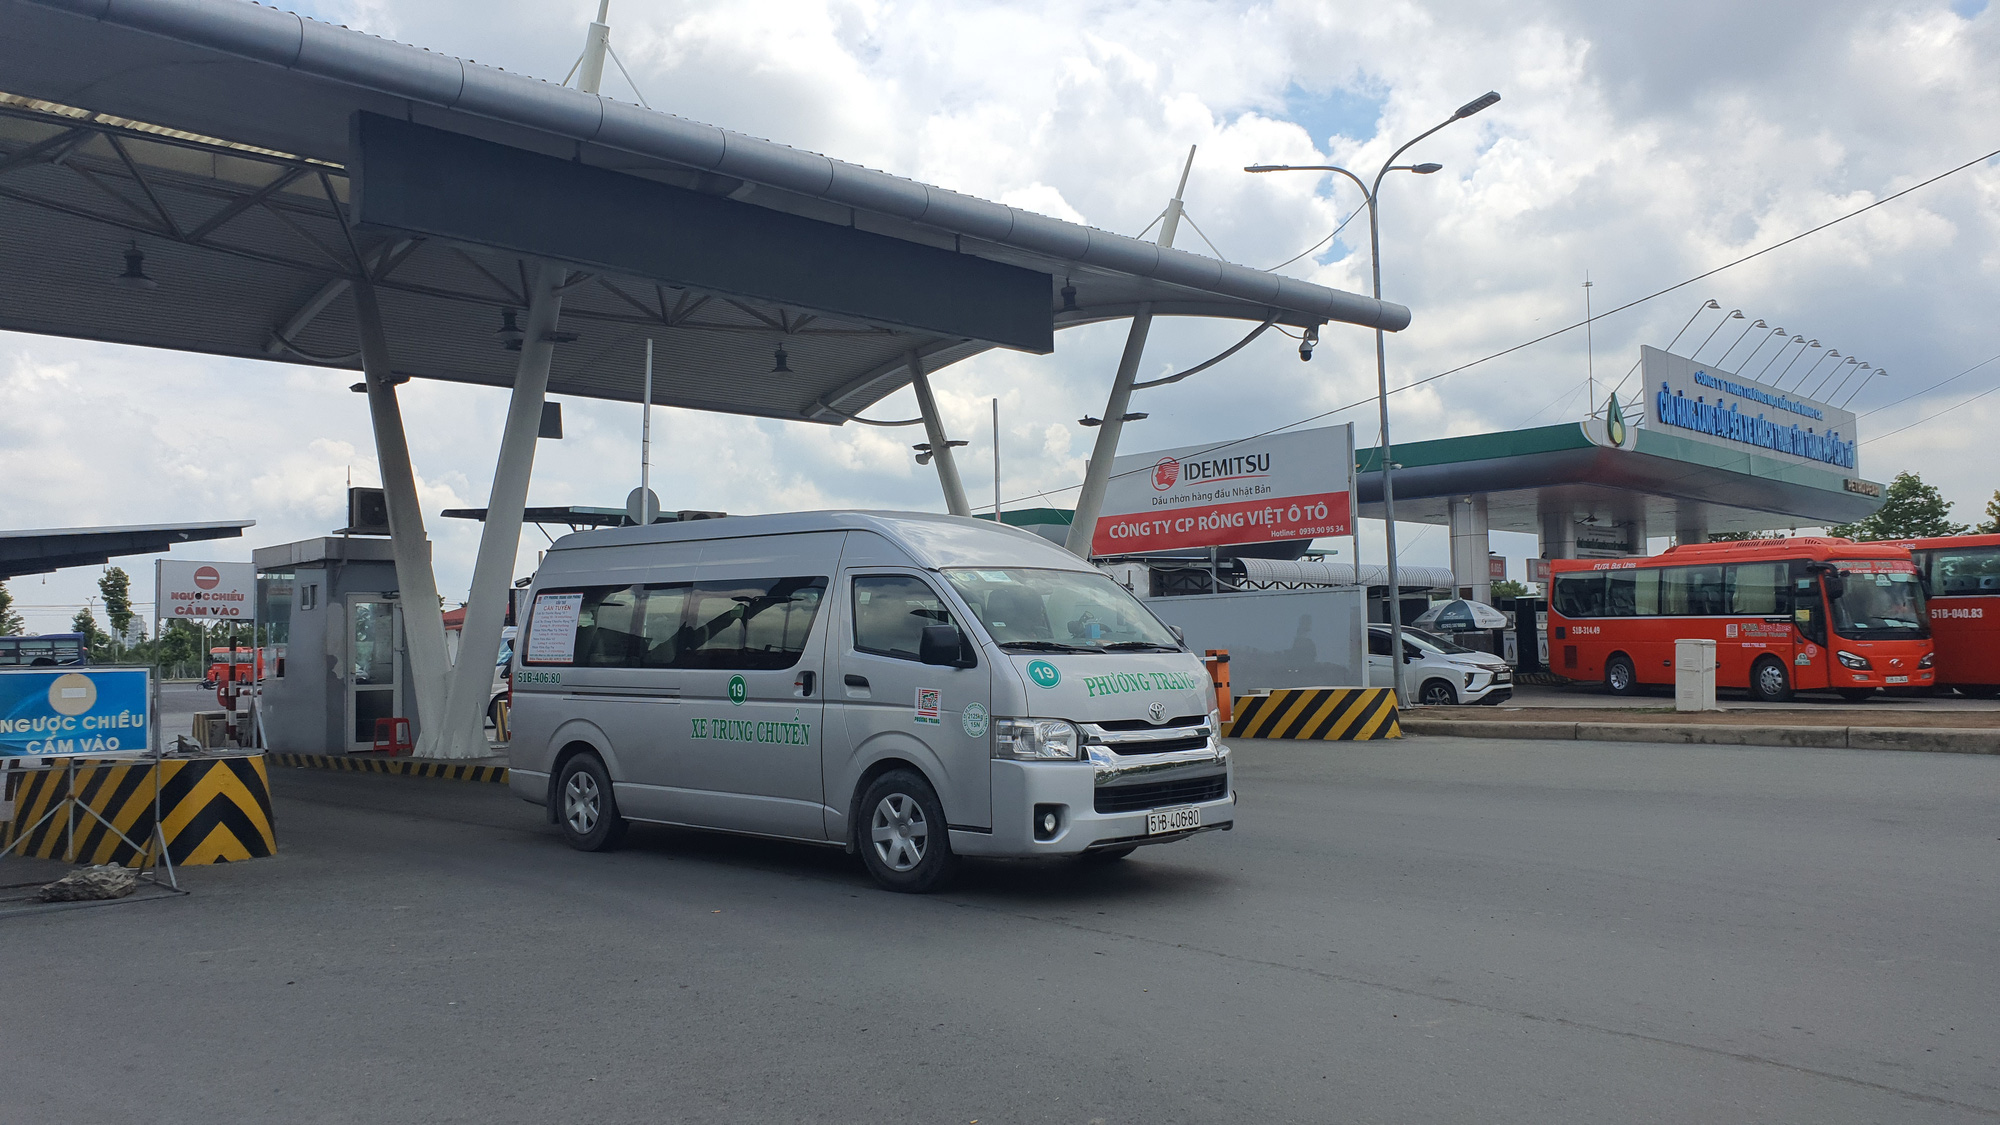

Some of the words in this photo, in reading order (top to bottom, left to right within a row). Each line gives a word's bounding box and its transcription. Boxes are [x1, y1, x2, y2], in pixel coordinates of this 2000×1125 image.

[1183, 452, 1271, 481] IDEMITSU
[1169, 494, 1190, 503] nhờn
[1192, 491, 1213, 502] hàng
[1232, 486, 1253, 498] Nhật
[1254, 484, 1272, 495] Bản
[1109, 521, 1151, 539] CÔNG
[1153, 519, 1171, 535] TY
[1175, 517, 1195, 533] CP
[1198, 510, 1244, 530] RỒNG
[1246, 506, 1284, 528] VIỆT
[1287, 503, 1301, 522] Ô
[1303, 501, 1329, 521] TÔ
[1271, 529, 1296, 538] Hotline:
[1299, 526, 1325, 535] 0939.90
[1325, 525, 1334, 534] 95
[1335, 524, 1344, 533] 34
[171, 591, 210, 603] NGƯỢC
[211, 589, 245, 601] CHIỀU
[174, 601, 207, 615] CẤM
[211, 604, 240, 616] VÀO
[1931, 608, 1983, 618] 51B-040.83
[518, 672, 561, 684] 51B-406.80
[1034, 666, 1055, 681] 19
[731, 683, 744, 697] 19
[1083, 671, 1151, 697] PHƯƠNG
[1150, 672, 1197, 690] TRANG
[0, 715, 76, 735] NGƯỢC
[82, 709, 144, 730] CHIỀU
[691, 718, 708, 739] XE
[711, 718, 753, 742] TRUNG
[756, 708, 811, 746] CHUYỂN
[26, 735, 74, 755] CẤM
[79, 733, 120, 751] VÀO
